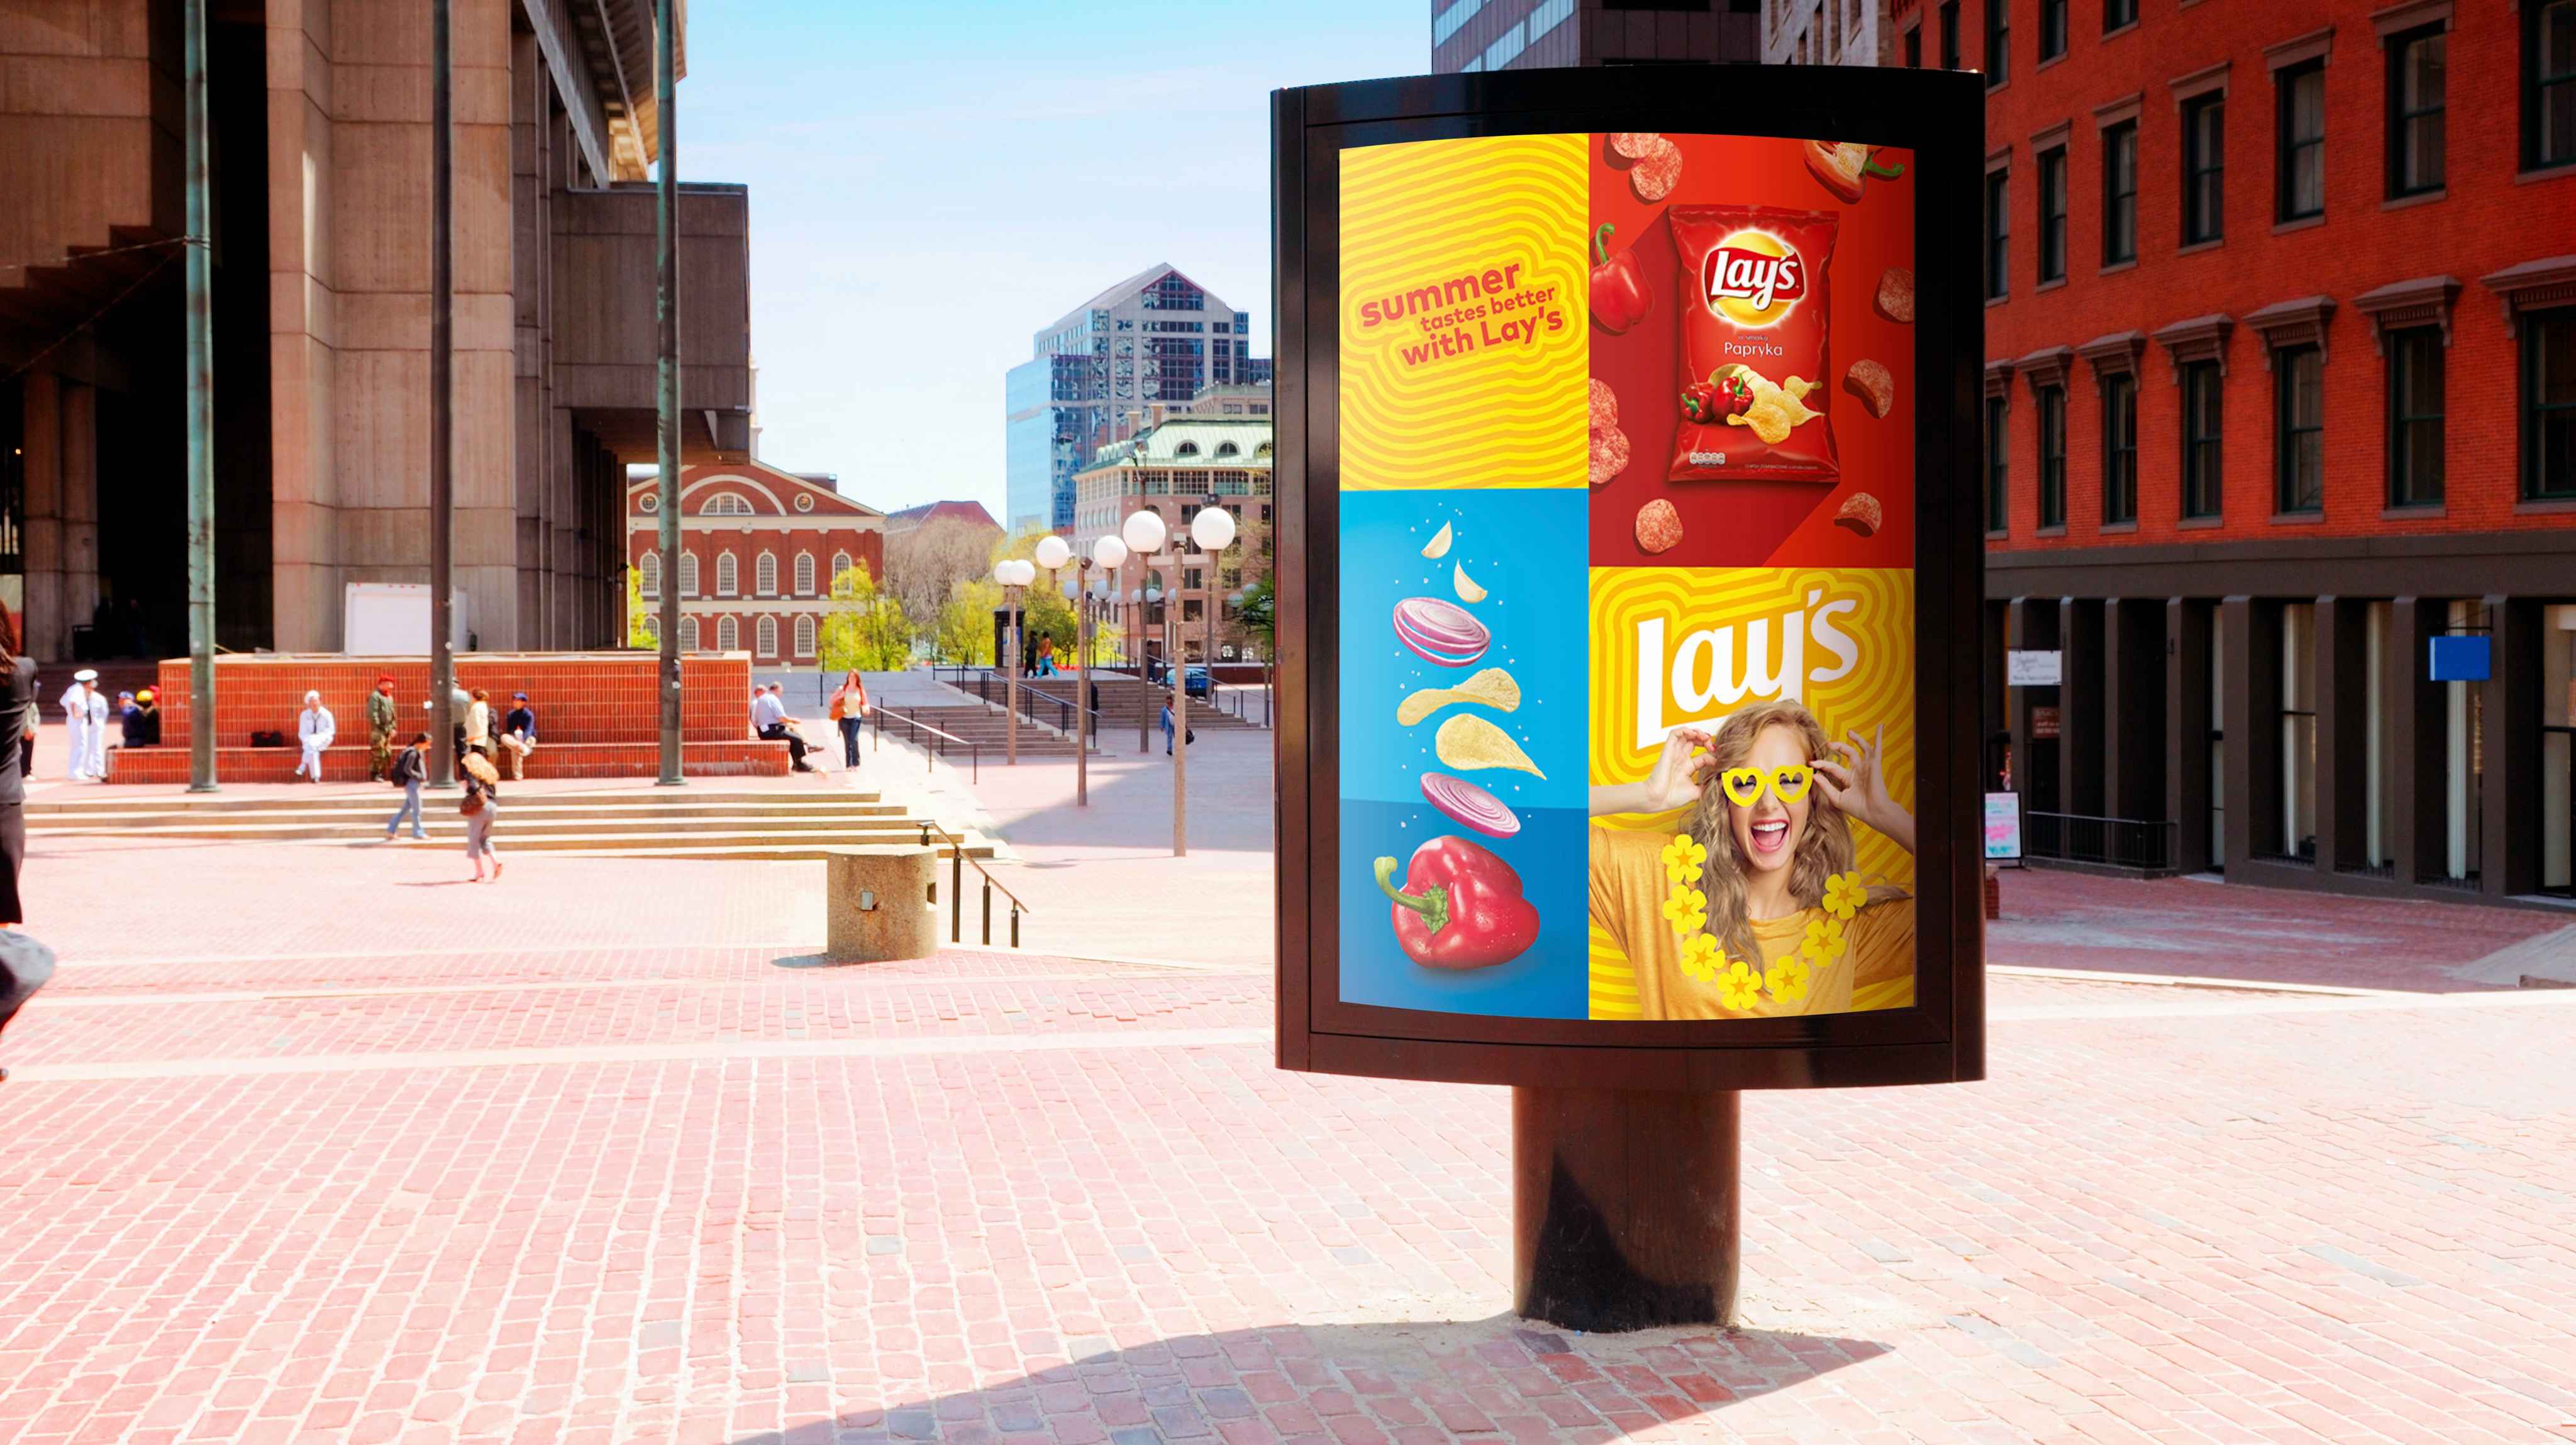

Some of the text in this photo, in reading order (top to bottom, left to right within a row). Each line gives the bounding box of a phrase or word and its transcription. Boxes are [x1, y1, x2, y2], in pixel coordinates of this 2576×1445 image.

[1360, 263, 1519, 328] summer
[1420, 287, 1555, 332] tastes better
[1710, 250, 1798, 311] Lay's
[1401, 306, 1563, 366] with Lay's
[1724, 341, 1782, 358] Papryka
[1636, 588, 1858, 751] Lay's
